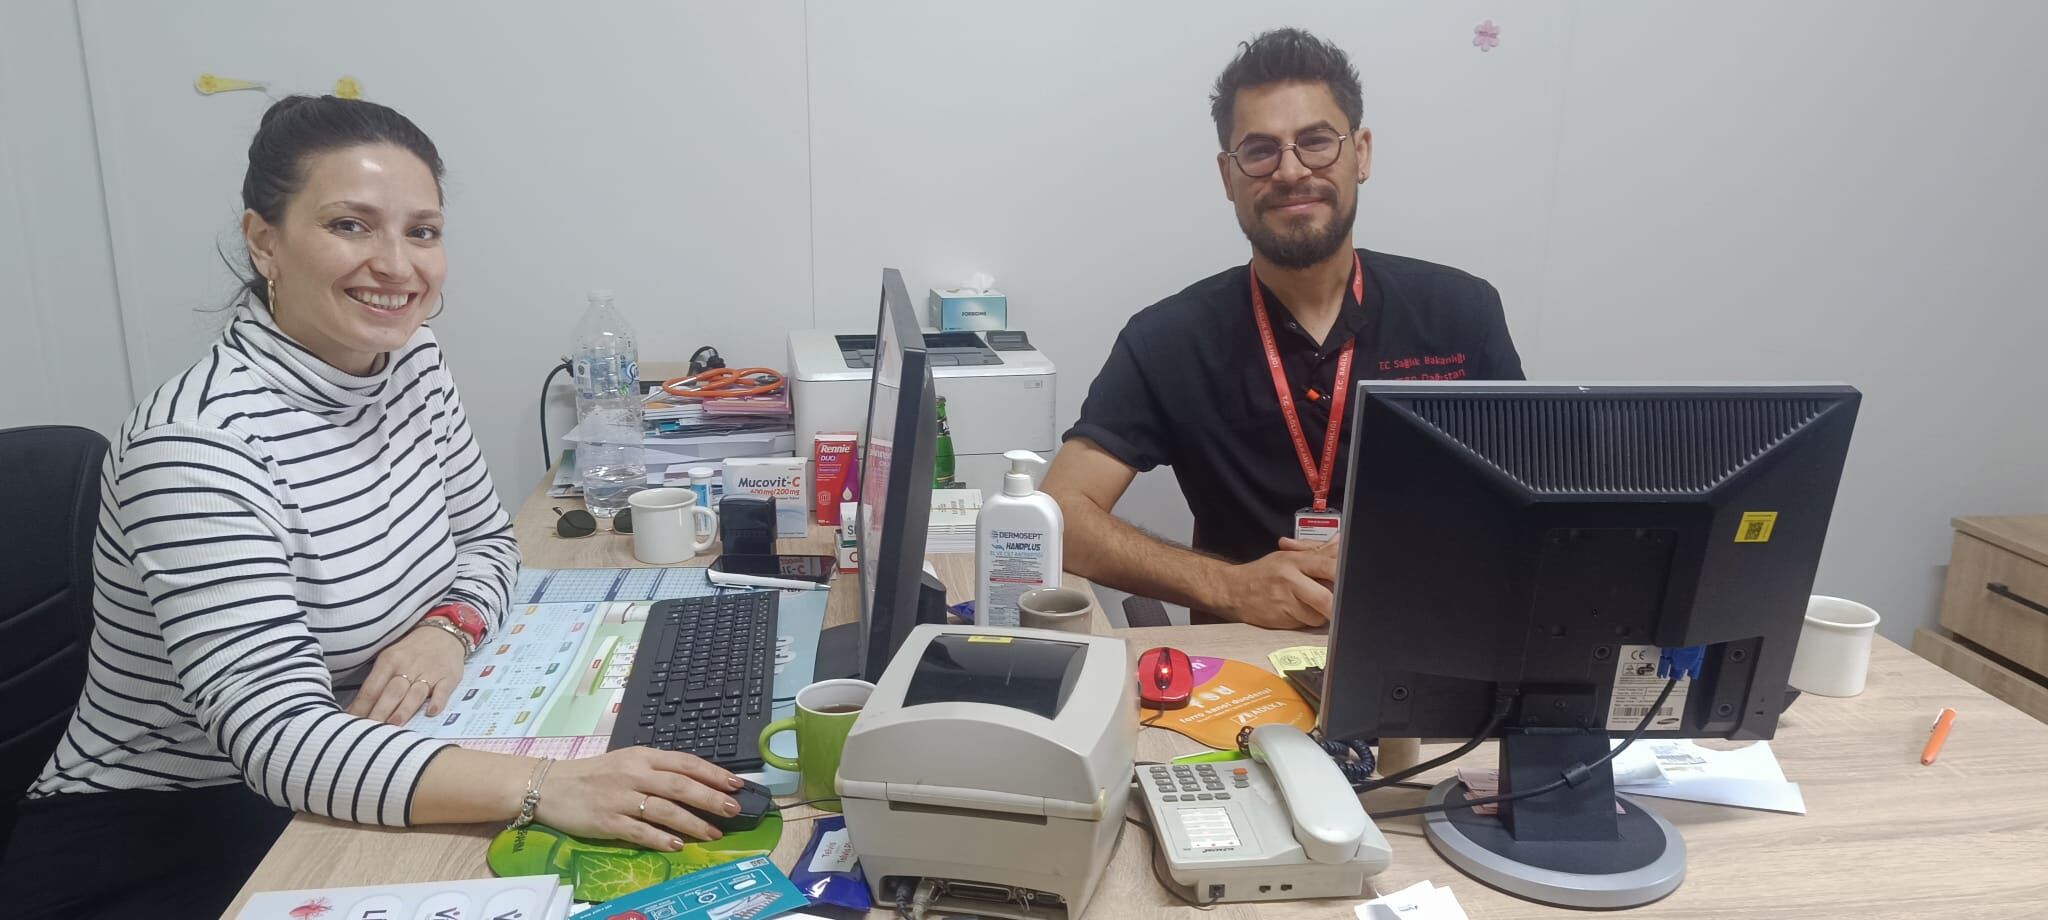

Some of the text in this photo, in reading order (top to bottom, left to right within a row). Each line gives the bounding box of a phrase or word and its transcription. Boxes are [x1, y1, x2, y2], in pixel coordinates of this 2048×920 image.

[820, 444, 850, 454] Rennie
[999, 531, 1042, 540] DERMOSEPT
[1006, 542, 1041, 551] HANDPLUS
